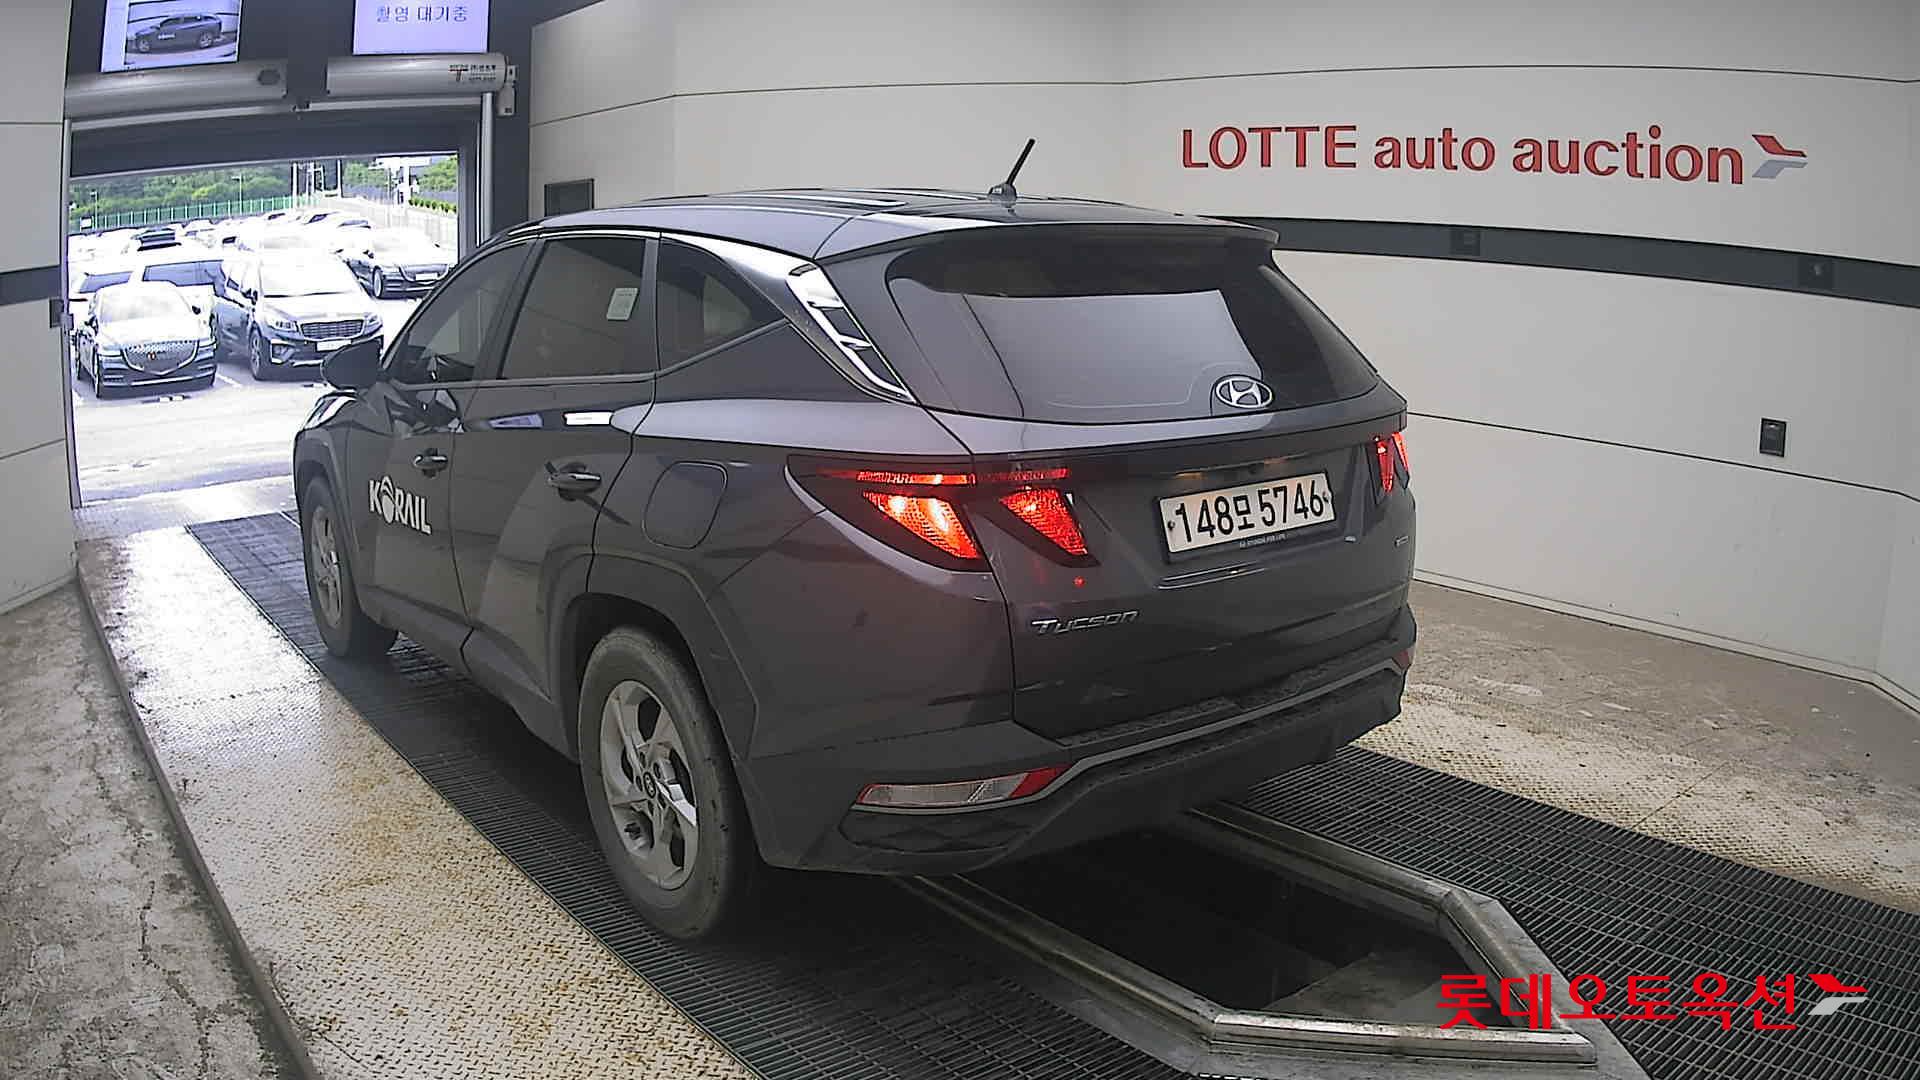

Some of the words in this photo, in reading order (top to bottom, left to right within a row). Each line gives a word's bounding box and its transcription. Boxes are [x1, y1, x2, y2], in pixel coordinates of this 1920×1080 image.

[416, 4, 468, 23] 대기중
[1181, 124, 1358, 169] LOTTE
[1373, 127, 1497, 171] auto
[1512, 124, 1745, 185] auction
[368, 475, 432, 535] KORAIL
